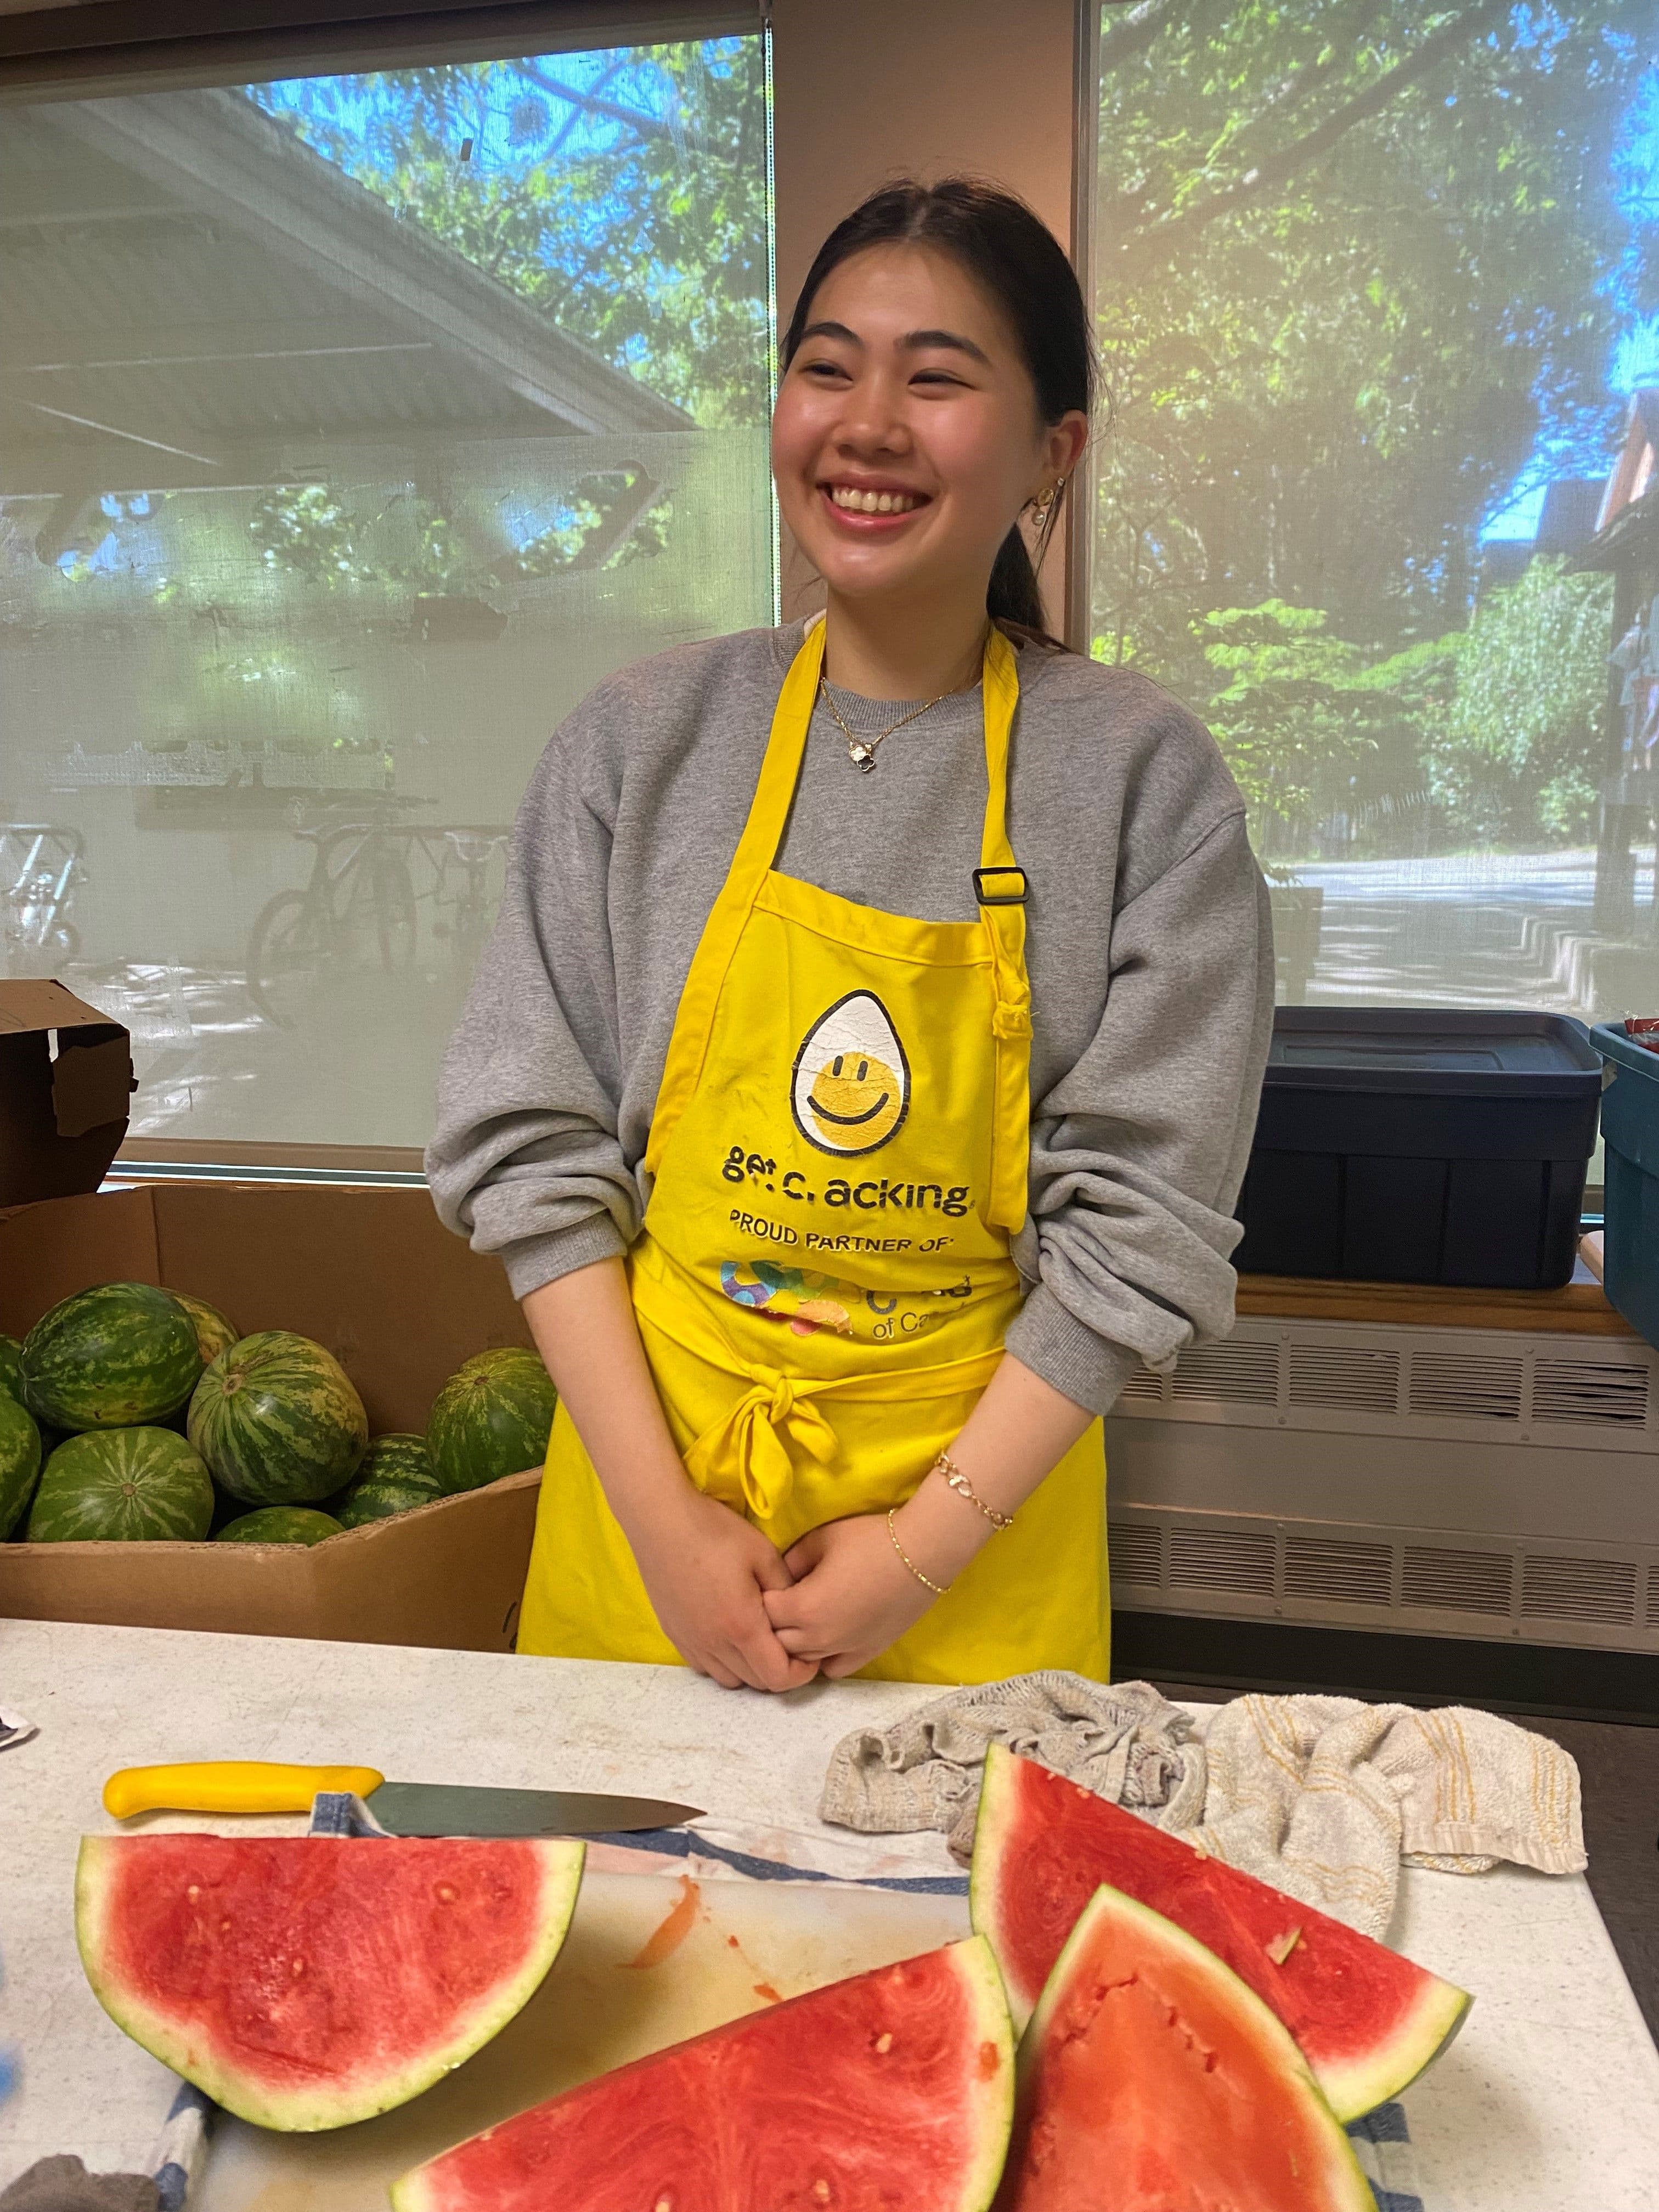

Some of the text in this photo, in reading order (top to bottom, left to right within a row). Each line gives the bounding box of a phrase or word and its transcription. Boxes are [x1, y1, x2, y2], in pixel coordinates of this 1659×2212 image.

[722, 1146, 777, 1191] get
[730, 1209, 798, 1244] PROUD
[805, 1233, 912, 1252] PARTNER
[873, 1317, 895, 1339] of
